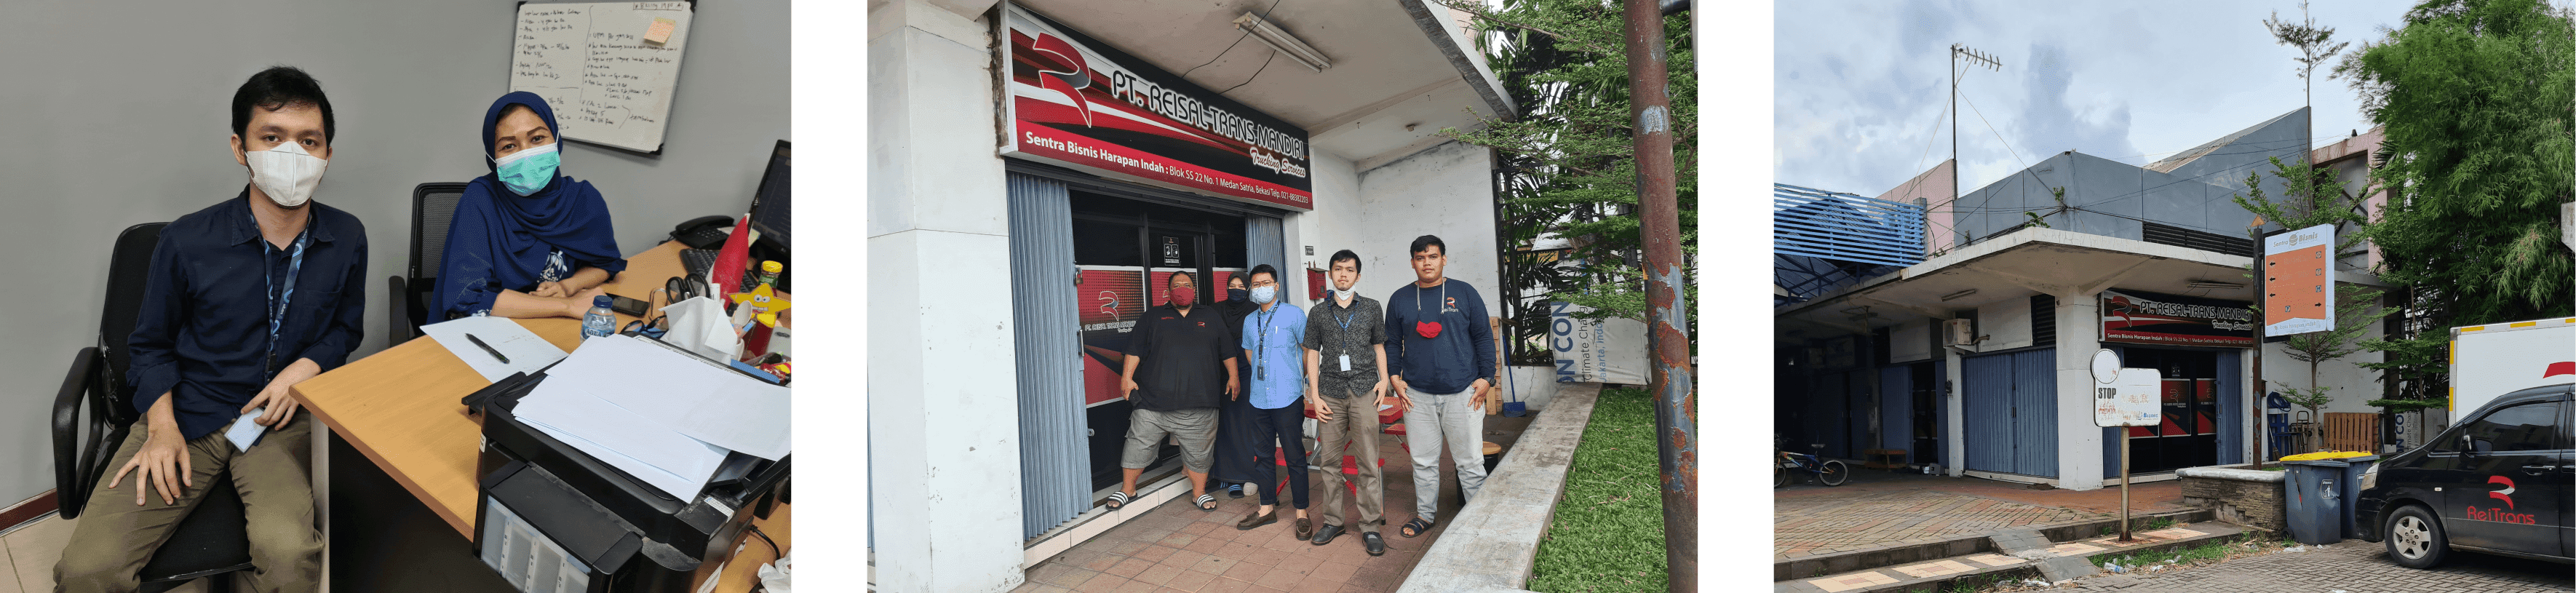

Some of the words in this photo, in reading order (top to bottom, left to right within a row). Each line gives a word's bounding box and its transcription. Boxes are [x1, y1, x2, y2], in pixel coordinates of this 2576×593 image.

[1113, 70, 1143, 105] PT.
[1150, 84, 1208, 128] REISAL
[1209, 107, 1255, 143] TRANS
[1257, 124, 1304, 159] MANDIRI
[1025, 131, 1065, 151] Sentra
[1067, 140, 1098, 159] Bisnis
[1100, 148, 1140, 167] Harapan
[1140, 158, 1164, 174] Indah
[1169, 165, 1185, 178] Blok
[1185, 170, 1194, 180] SS
[1195, 172, 1203, 183] 22
[1204, 175, 1215, 186] No.
[1215, 177, 1219, 186] 1
[1220, 178, 1239, 190] Medan
[1239, 182, 1255, 194] Satria,
[1255, 185, 1271, 196] Bekasi
[1271, 187, 1281, 199] Telp.
[1251, 148, 1280, 173] Trucking
[1281, 159, 1305, 177] Services
[2273, 239, 2289, 247] Sentra
[2298, 231, 2318, 242] Bisnis
[2140, 301, 2155, 314] PT.
[2156, 302, 2187, 317] REISAL
[2188, 305, 2216, 318] TRANS
[2212, 319, 2233, 331] Trucking
[1581, 342, 1592, 381] Climate
[1597, 346, 1607, 383] Jakarta,
[2098, 387, 2117, 399] STOP
[2467, 506, 2536, 525] ReiTrans
